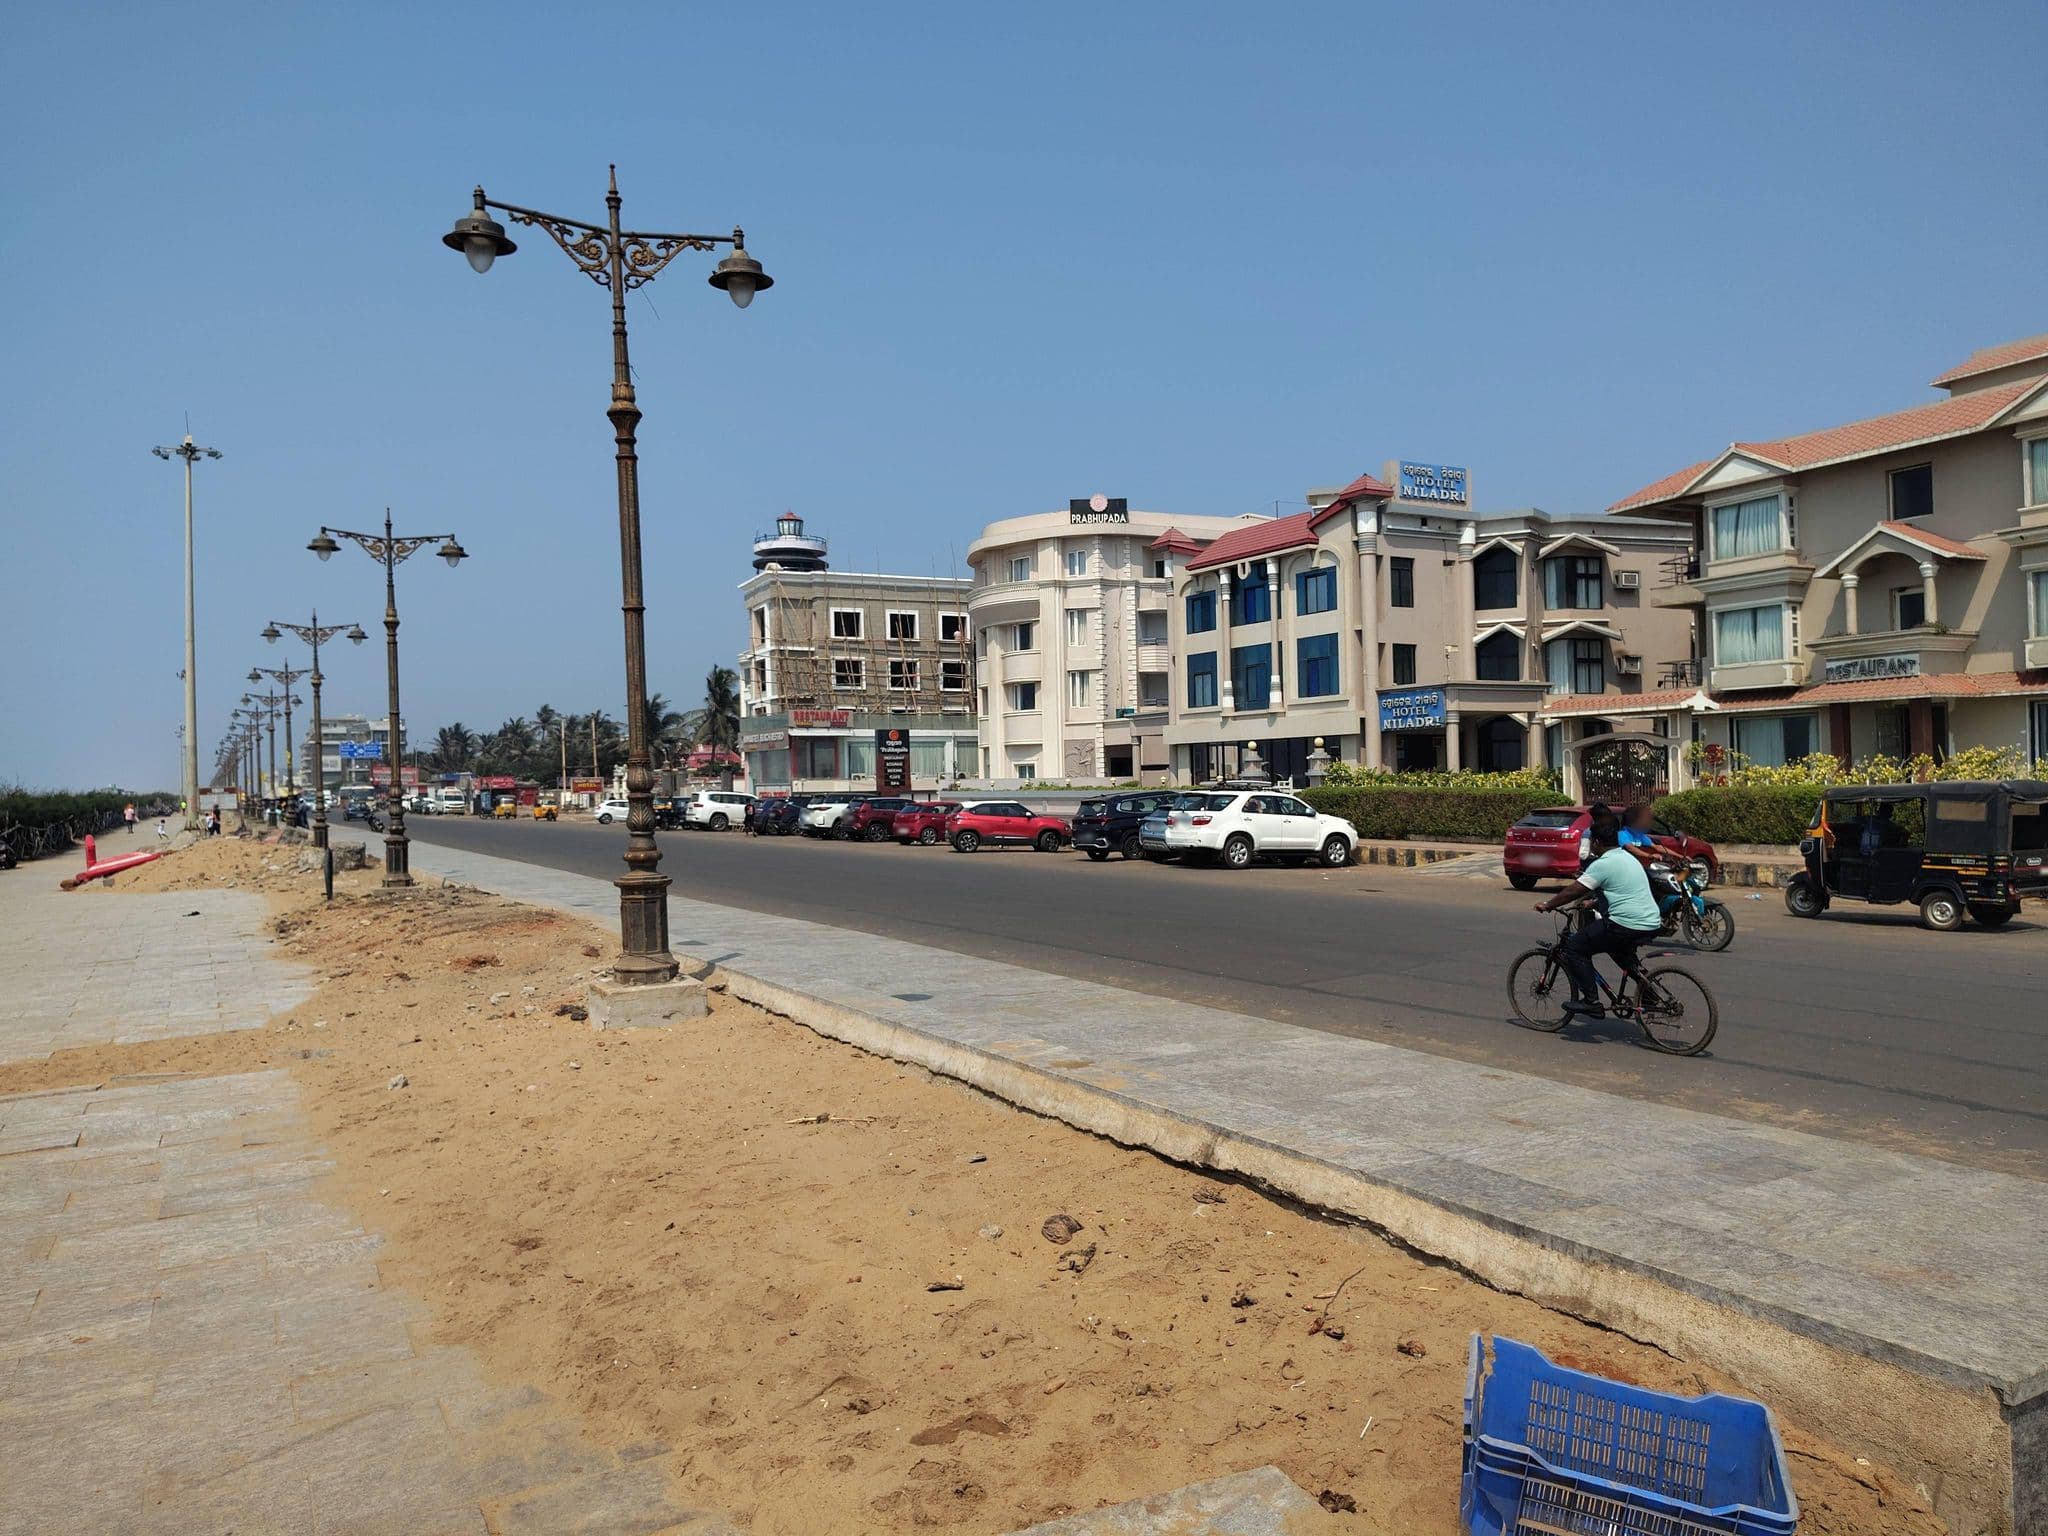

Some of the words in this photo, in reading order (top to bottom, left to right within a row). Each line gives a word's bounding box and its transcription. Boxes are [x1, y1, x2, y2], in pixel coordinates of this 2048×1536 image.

[1416, 476, 1456, 489] HOTEL
[1403, 485, 1466, 501] NILADRI
[1072, 513, 1127, 523] PRABHUPADA
[1826, 658, 1916, 681] RESTAURANT
[794, 710, 849, 721] RESTAURANT
[1393, 706, 1428, 717] HOTEL
[1384, 716, 1441, 729] NILADRI
